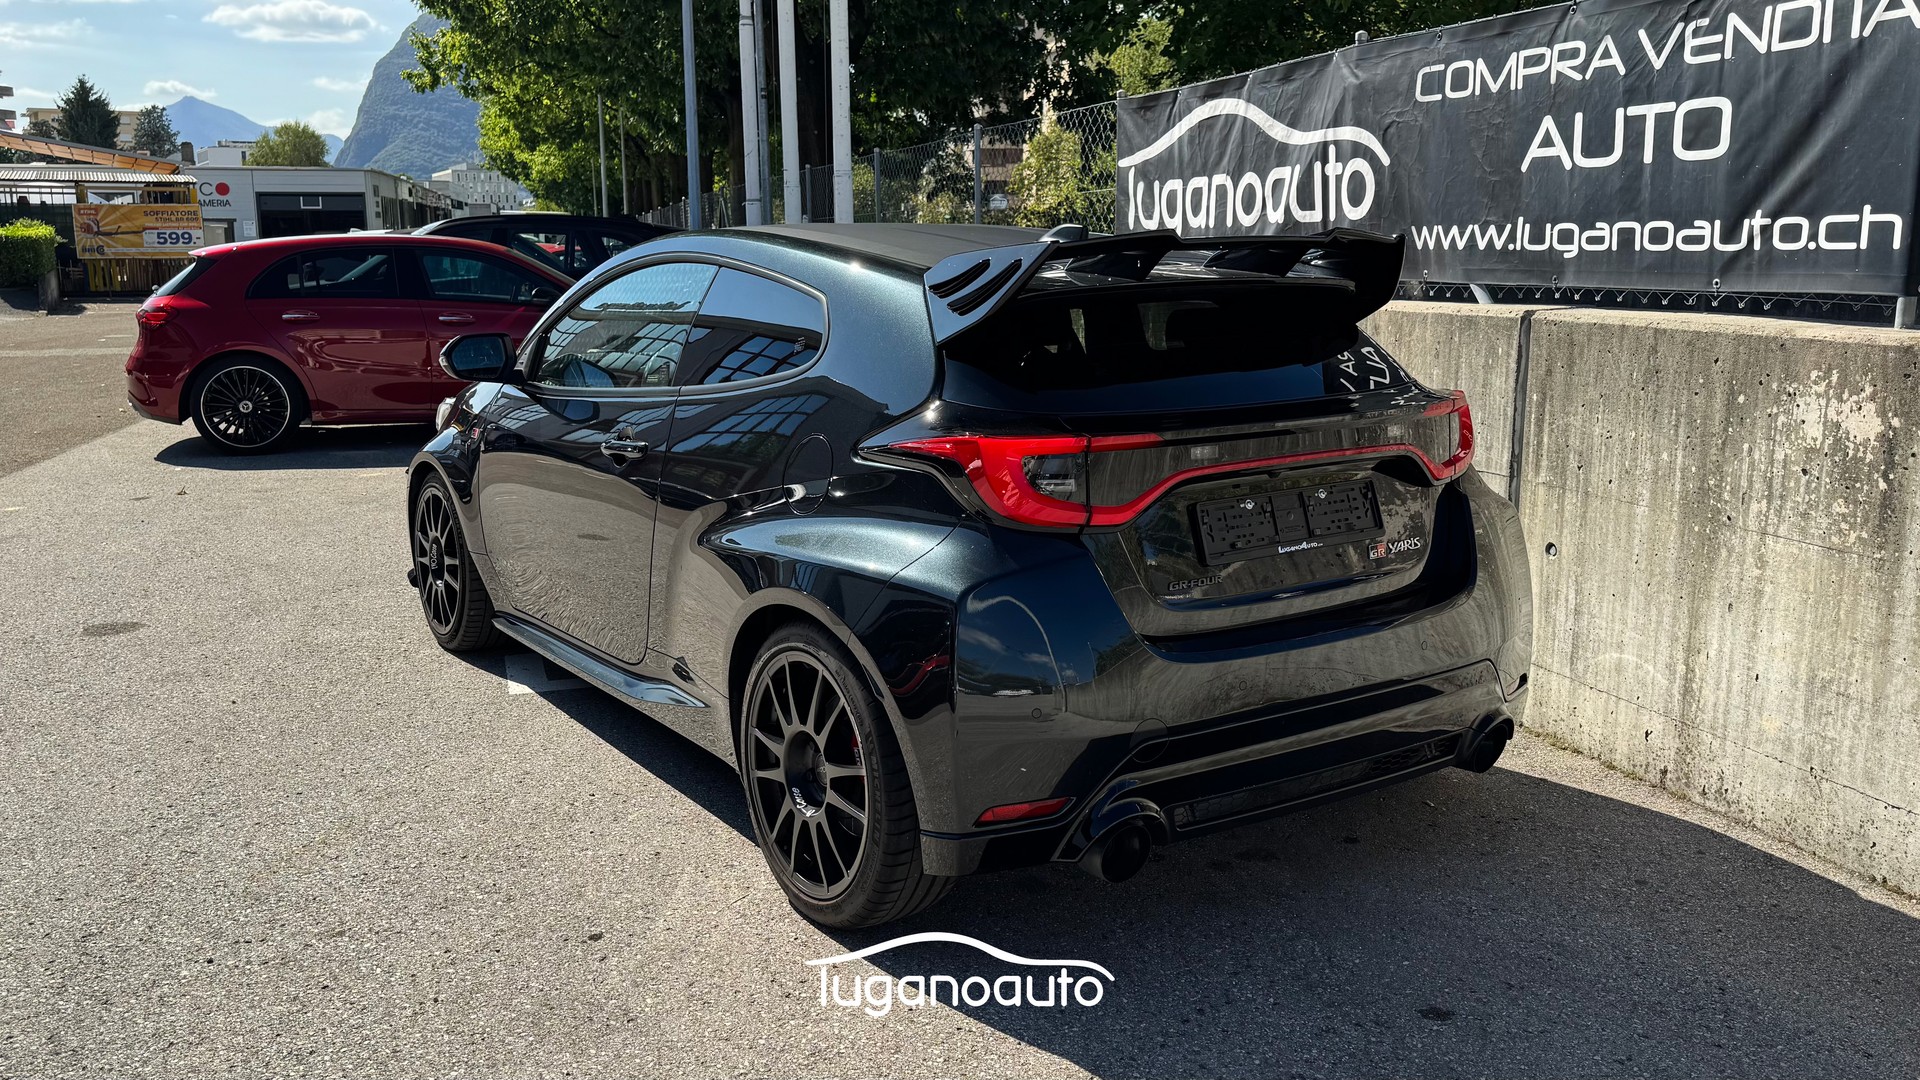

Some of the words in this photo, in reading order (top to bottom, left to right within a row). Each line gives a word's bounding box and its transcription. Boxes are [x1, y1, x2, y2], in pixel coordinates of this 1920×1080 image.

[1415, 34, 1626, 102] COMPRA
[1521, 97, 1733, 173] AUTO
[1127, 144, 1376, 236] luganoauto
[156, 231, 201, 246] 599.-
[1411, 205, 1903, 258] www.luganoauto.ch
[1369, 546, 1387, 560] GR
[1388, 537, 1421, 554] YARIS
[869, 755, 881, 843] MICHELIN
